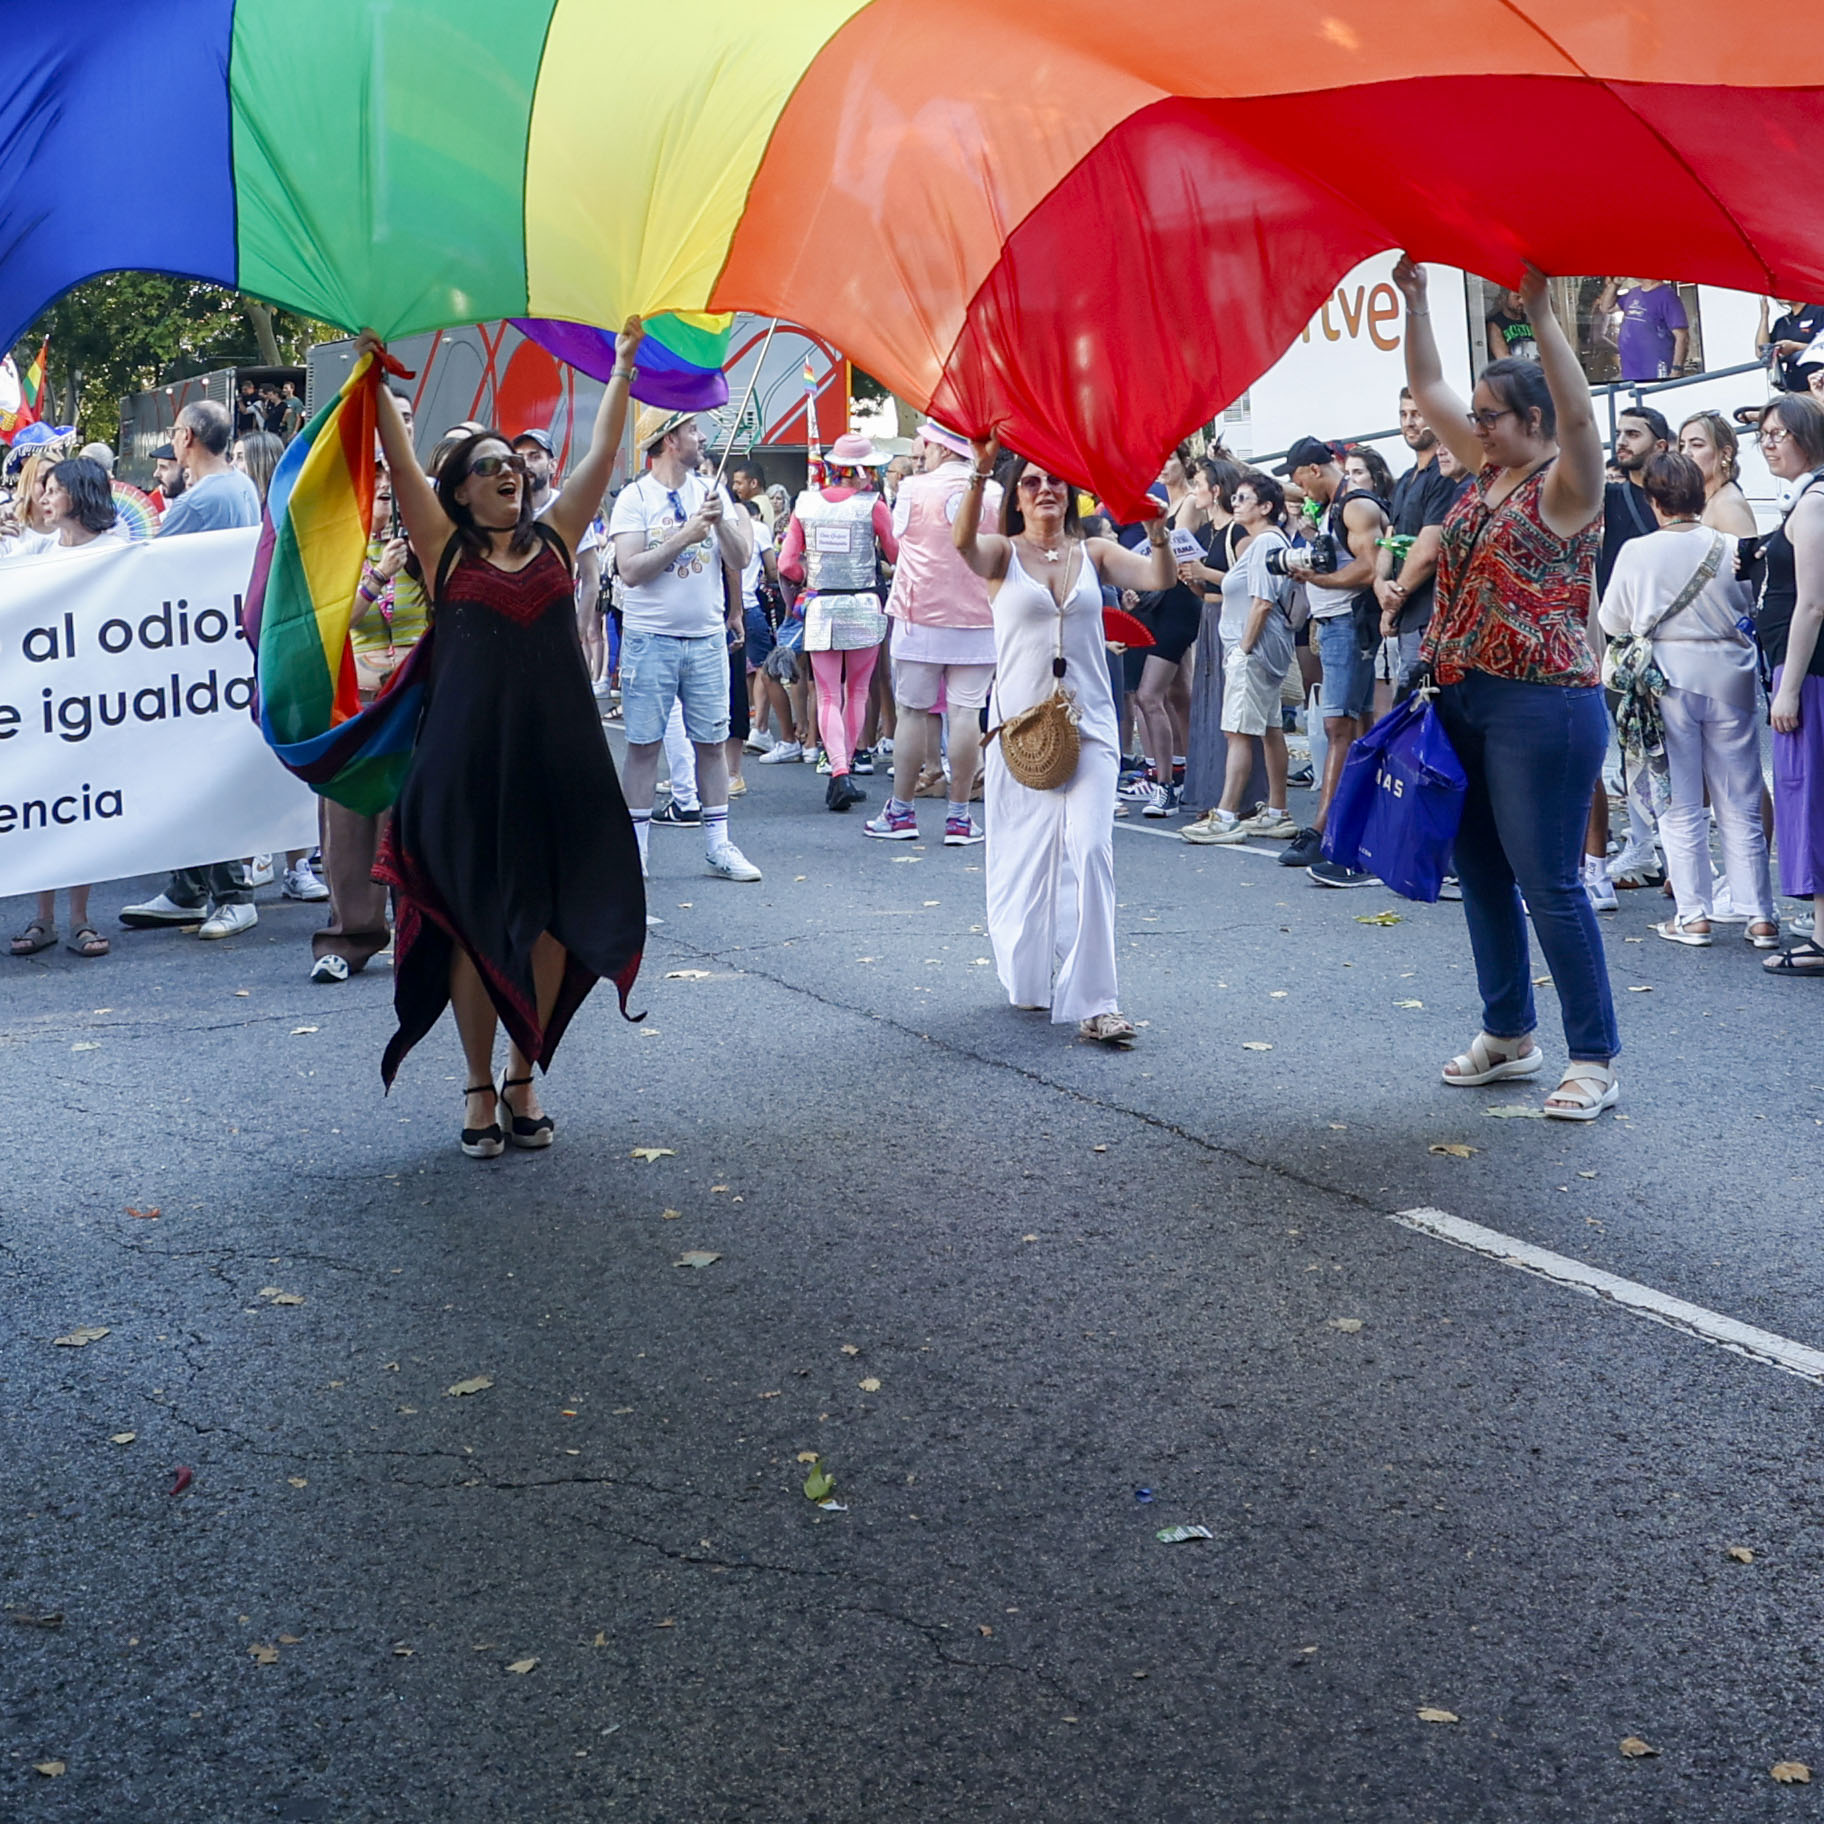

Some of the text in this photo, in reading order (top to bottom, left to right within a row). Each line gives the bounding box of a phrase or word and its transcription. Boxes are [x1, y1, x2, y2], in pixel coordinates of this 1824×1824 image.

[1302, 283, 1400, 351] tve
[22, 612, 76, 662] al
[98, 594, 246, 654] odio!
